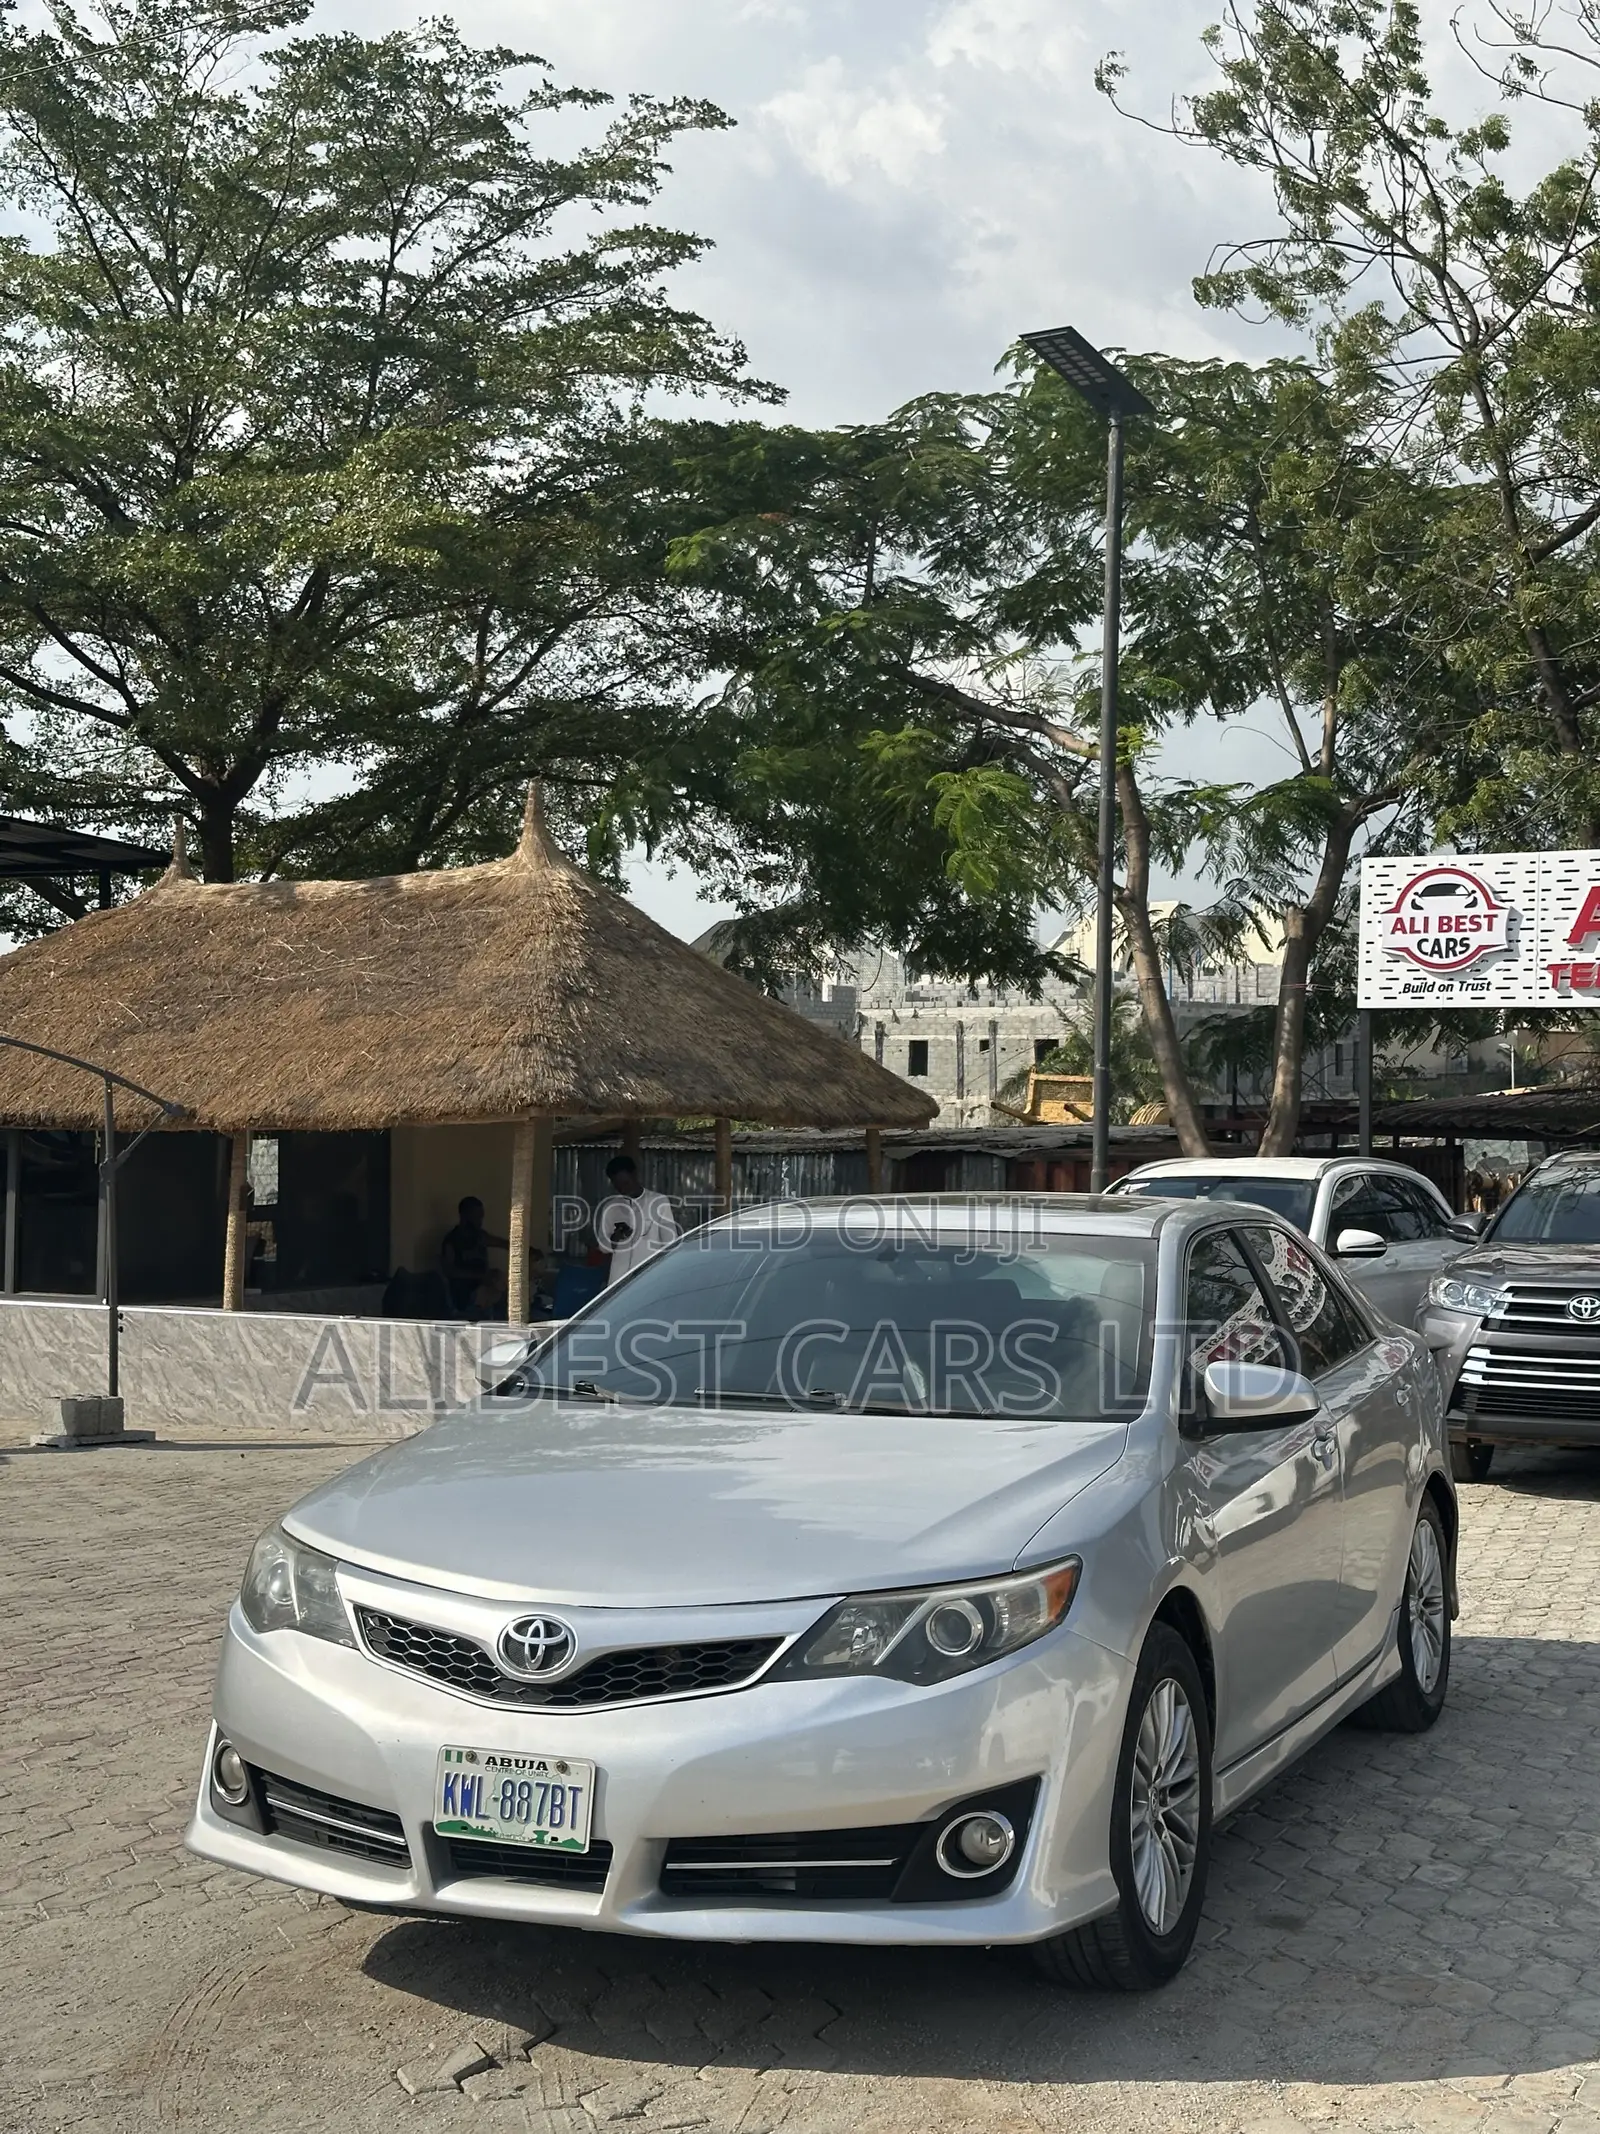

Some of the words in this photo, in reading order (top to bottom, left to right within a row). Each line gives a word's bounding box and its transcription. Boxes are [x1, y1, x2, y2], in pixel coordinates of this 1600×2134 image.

[1390, 916, 1429, 935] ALI
[1437, 914, 1499, 933] BEST
[1416, 937, 1471, 959] CARS
[1546, 962, 1600, 989] TE
[1438, 983, 1454, 993] on
[1459, 980, 1492, 992] Trust
[484, 1765, 513, 1775] CENTRE
[485, 1756, 549, 1771] ABUJA
[443, 1772, 583, 1830] KWL-887BT
